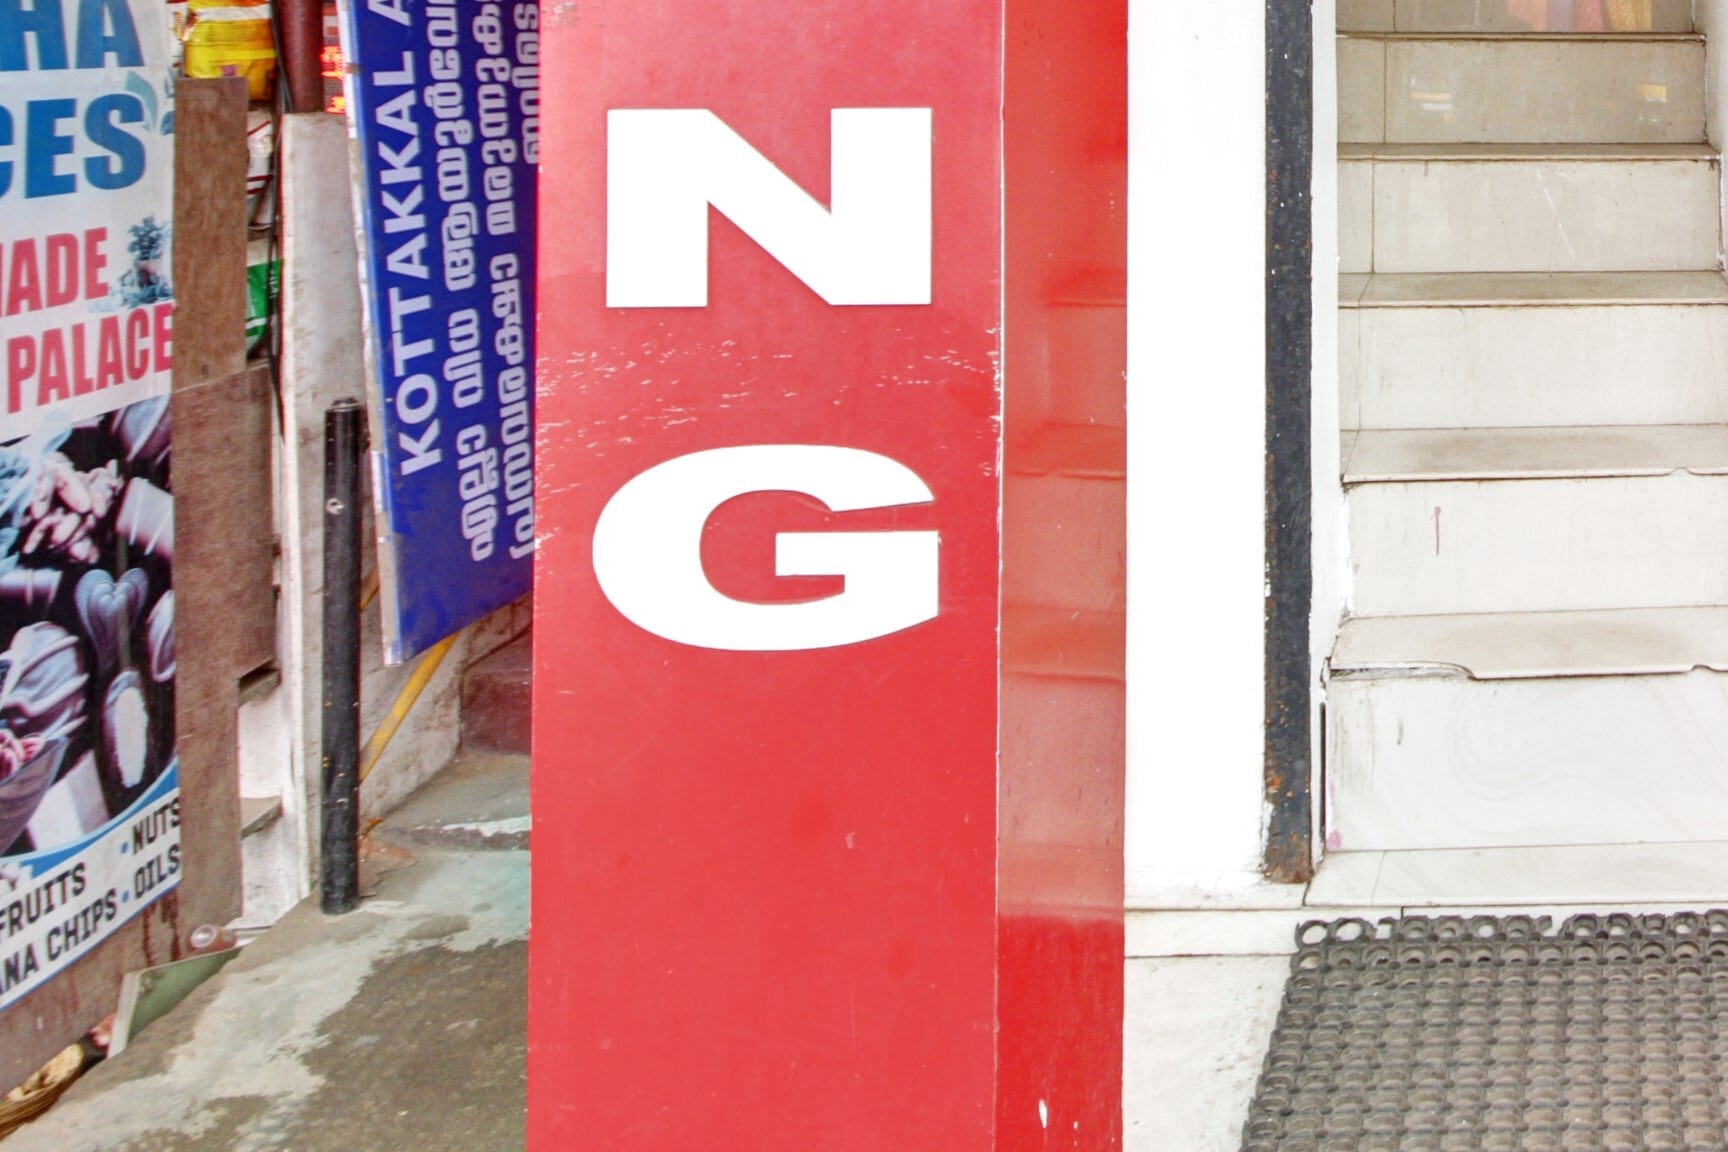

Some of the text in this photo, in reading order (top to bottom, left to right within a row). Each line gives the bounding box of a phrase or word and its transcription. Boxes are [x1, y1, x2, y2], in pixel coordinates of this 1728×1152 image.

[0, 93, 146, 200] ES
[0, 227, 109, 318] ADE
[371, 50, 443, 476] KOTTAKKAL
[7, 302, 173, 415] PALACE
[443, 308, 486, 409] വിധ
[455, 424, 499, 562] എല്ലാ
[132, 796, 181, 855] NUTS
[134, 843, 180, 899] OILS
[0, 887, 117, 996] NA CHIPS
